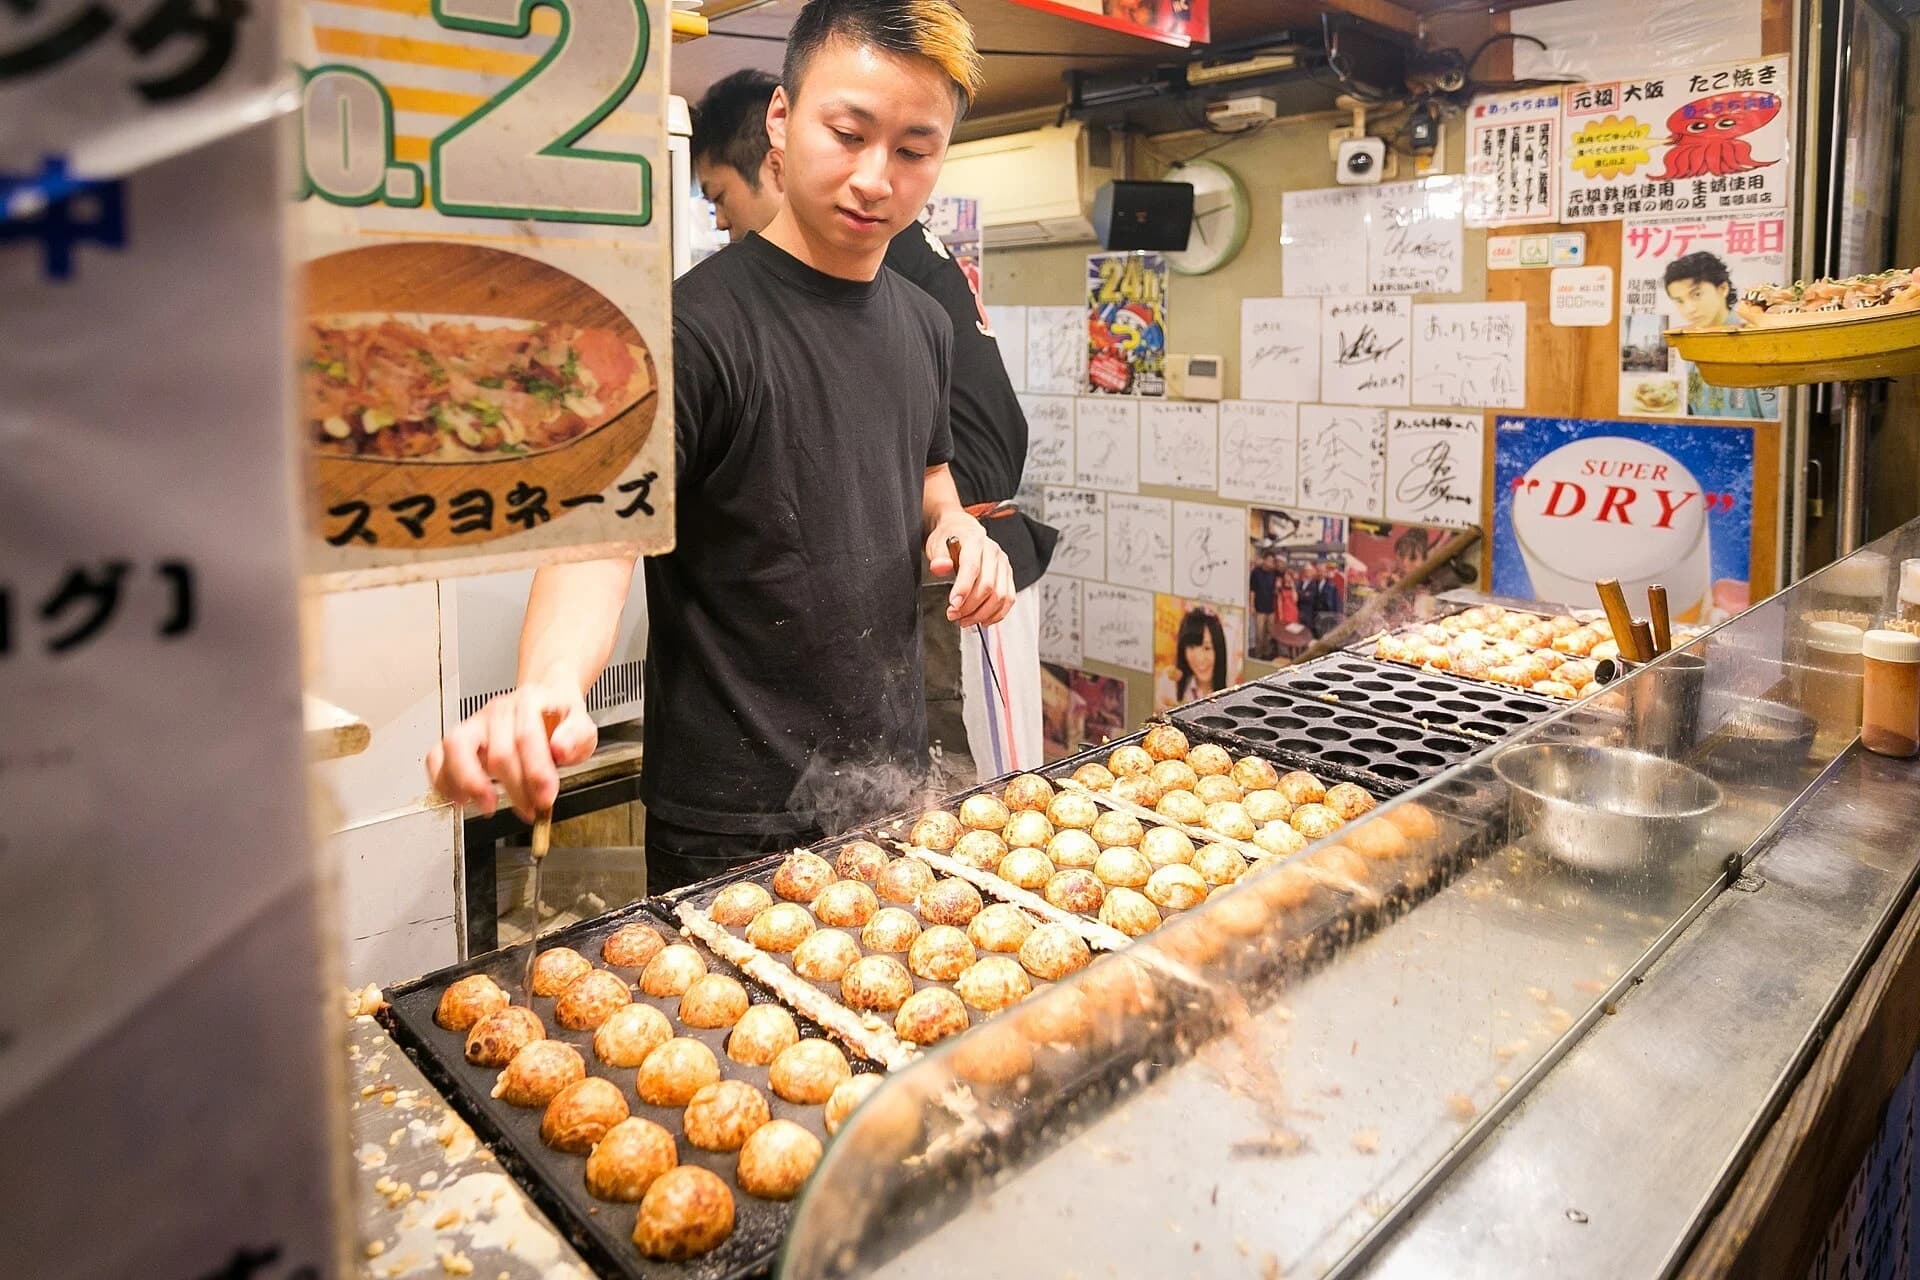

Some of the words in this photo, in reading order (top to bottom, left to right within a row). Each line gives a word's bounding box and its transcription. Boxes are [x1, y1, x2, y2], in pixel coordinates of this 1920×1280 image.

[1575, 89, 1613, 109] 元祖
[1624, 81, 1664, 102] 大阪
[1689, 65, 1777, 93] たこ焼き
[294, 0, 652, 226] o.2
[1627, 219, 1785, 259] サンデー毎日
[1581, 459, 1669, 481] SUPER
[325, 471, 658, 546] スマヨネーズ
